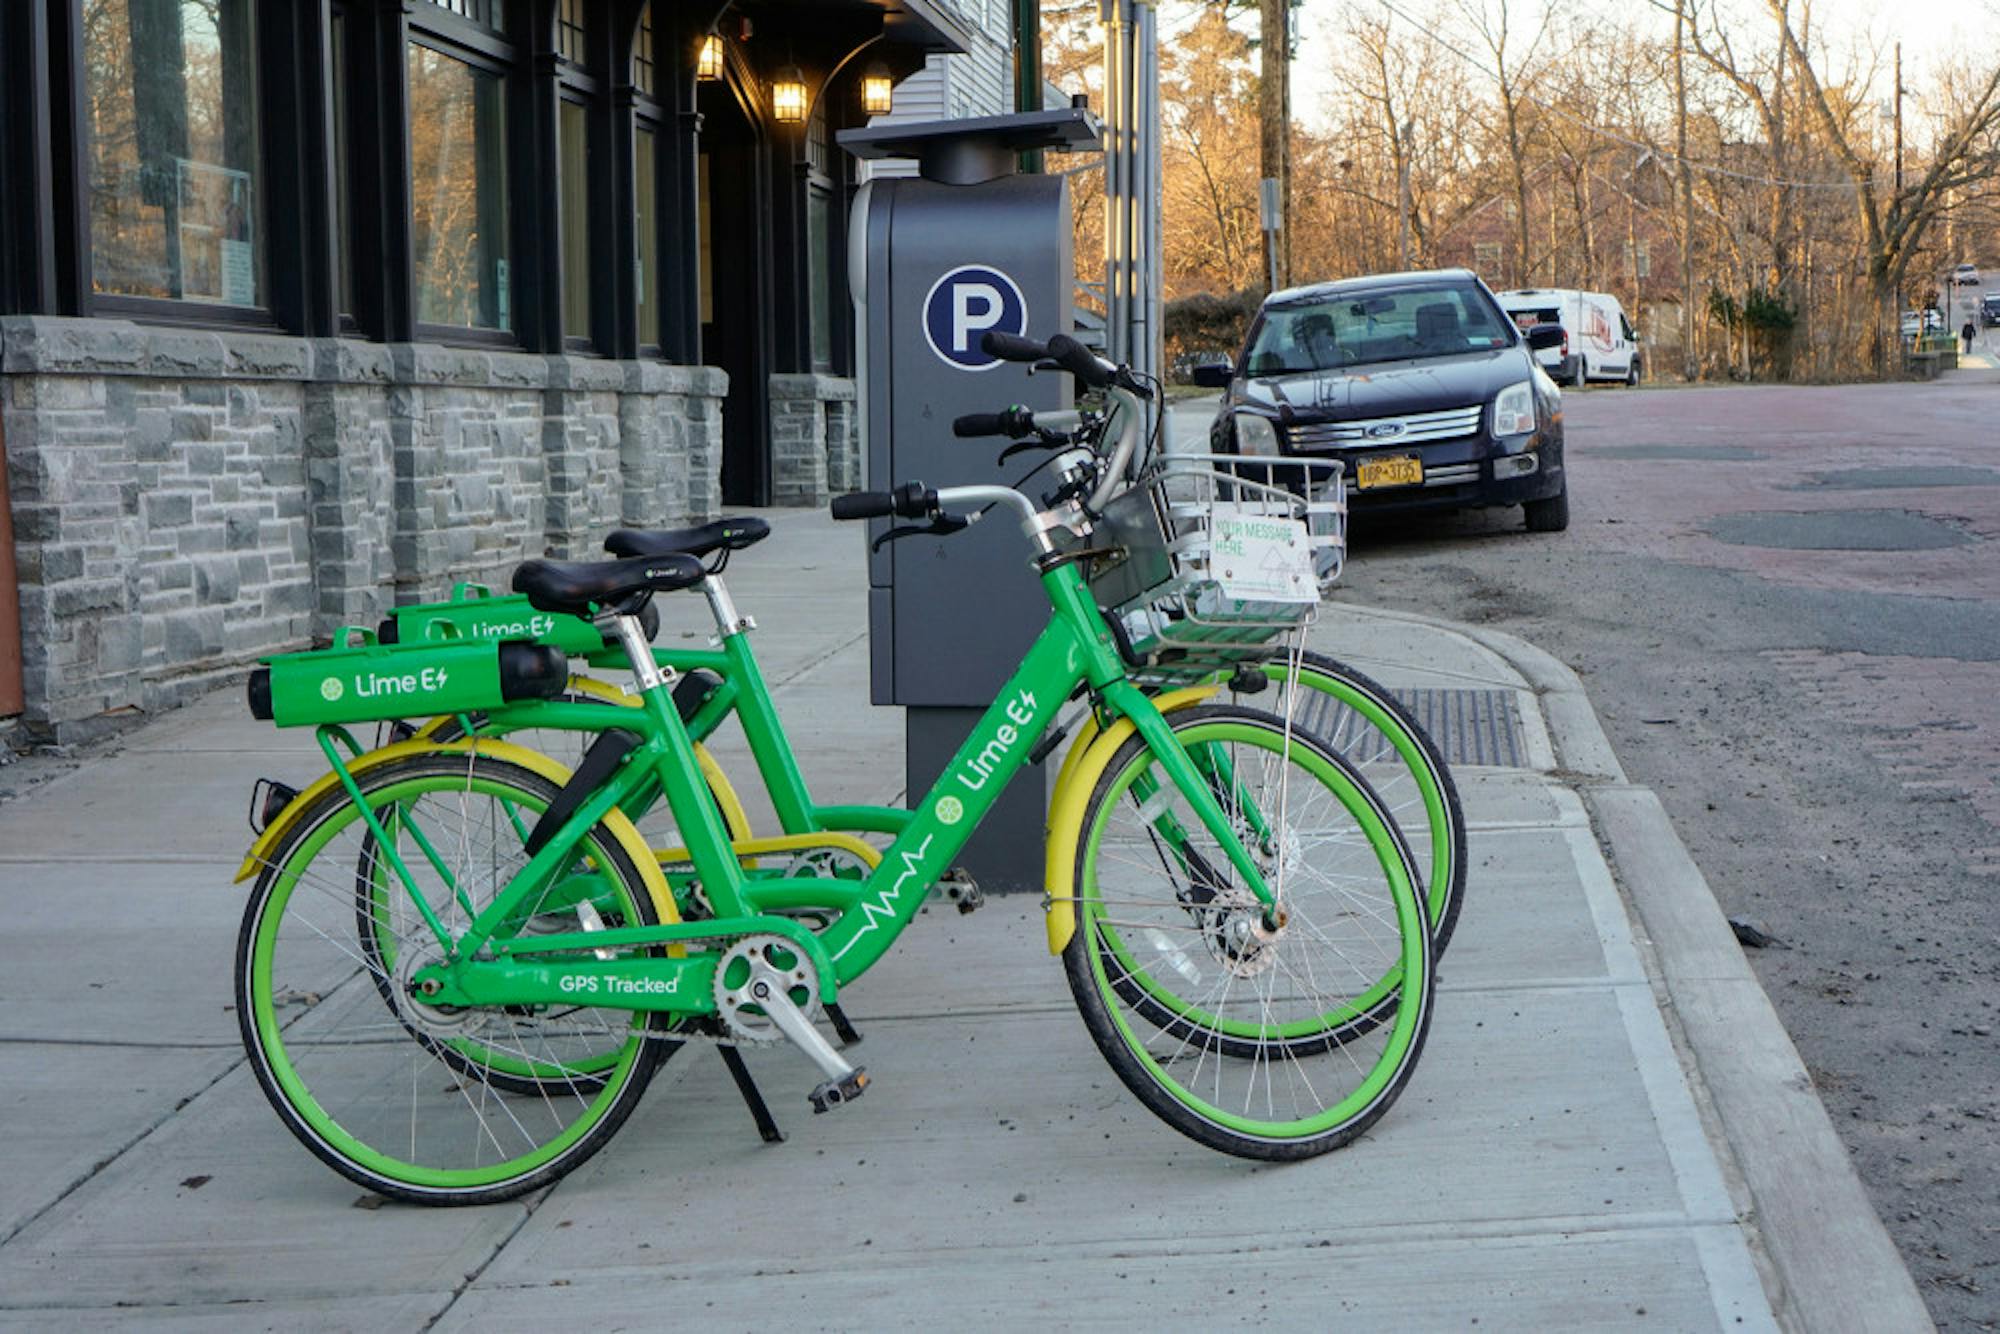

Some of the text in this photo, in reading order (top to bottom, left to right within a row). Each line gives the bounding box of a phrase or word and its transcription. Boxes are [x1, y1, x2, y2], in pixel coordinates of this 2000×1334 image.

[953, 283, 1004, 352] P
[1215, 519, 1293, 541] YOUR MESSAGE
[355, 672, 417, 697] Lime
[956, 723, 1018, 791] Lime
[559, 975, 678, 993] GPS Tracked
